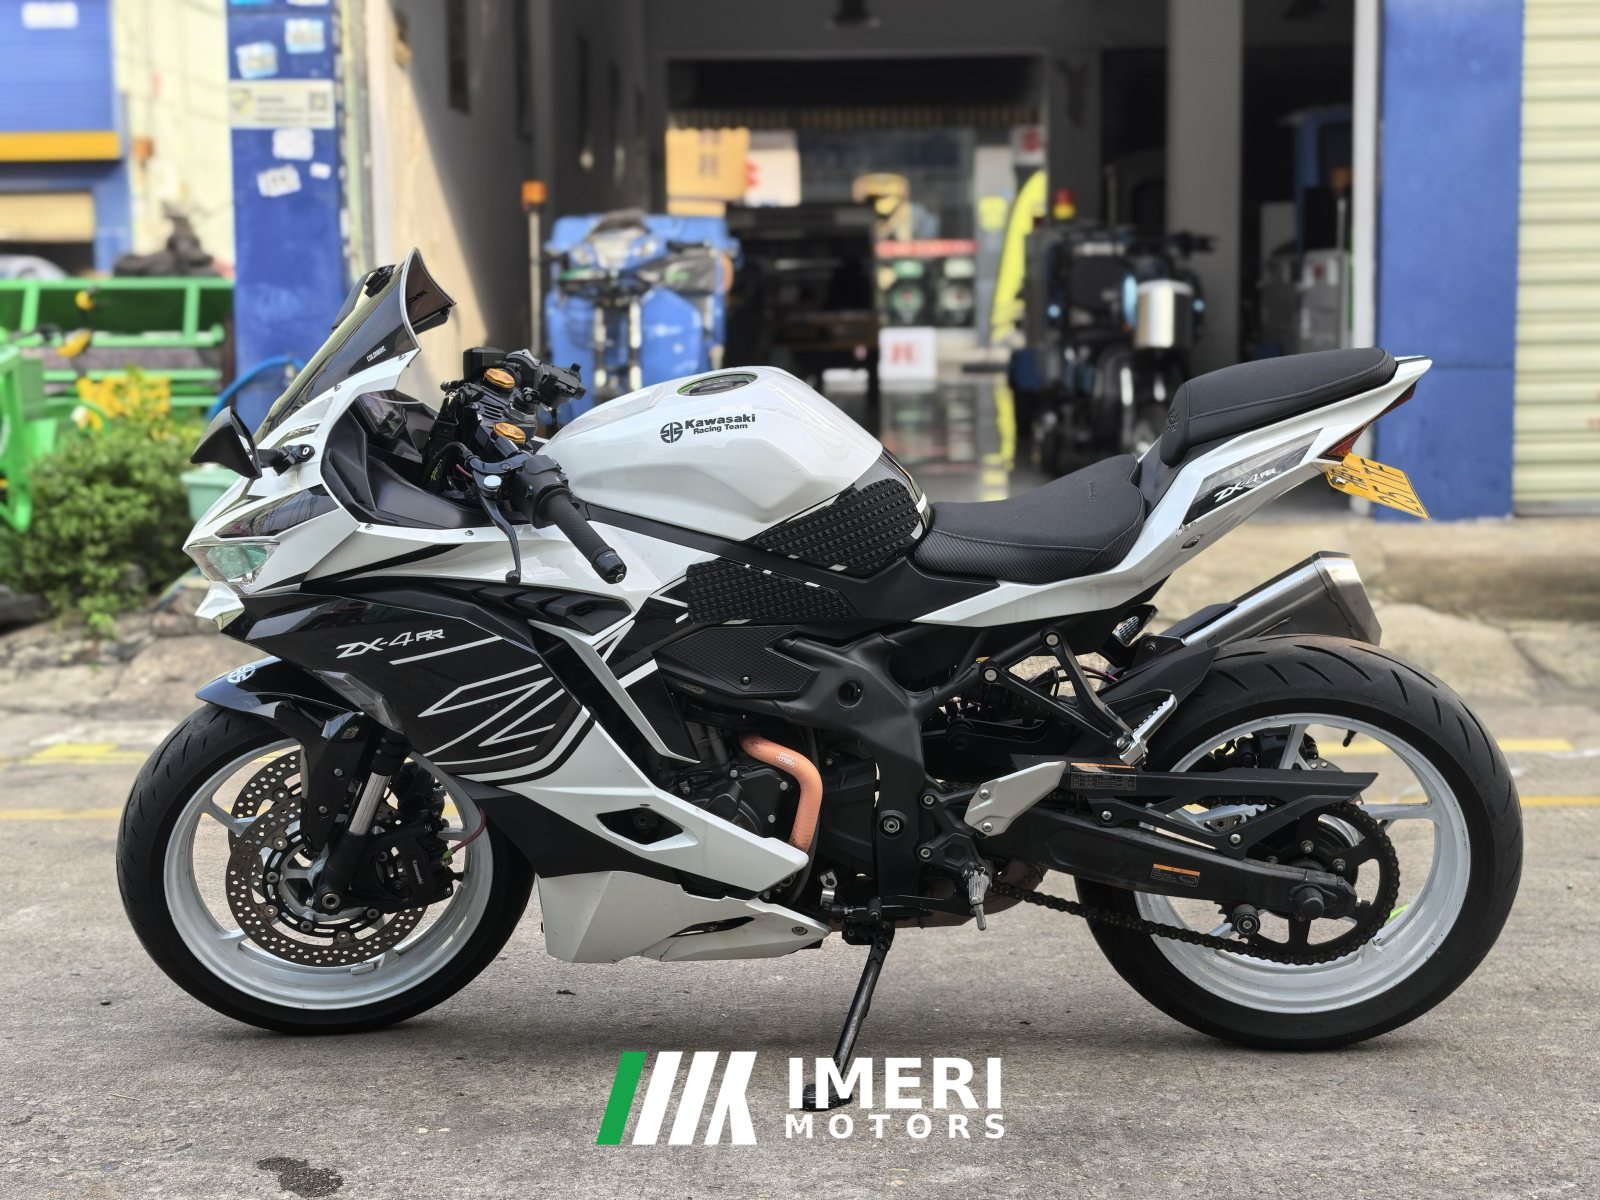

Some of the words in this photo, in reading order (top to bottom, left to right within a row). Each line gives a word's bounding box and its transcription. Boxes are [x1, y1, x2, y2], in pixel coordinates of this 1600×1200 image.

[685, 414, 755, 429] Kawasaki
[693, 426, 722, 435] Racing
[1213, 468, 1276, 503] ZX-4RR
[335, 628, 446, 659] ZX-4RR
